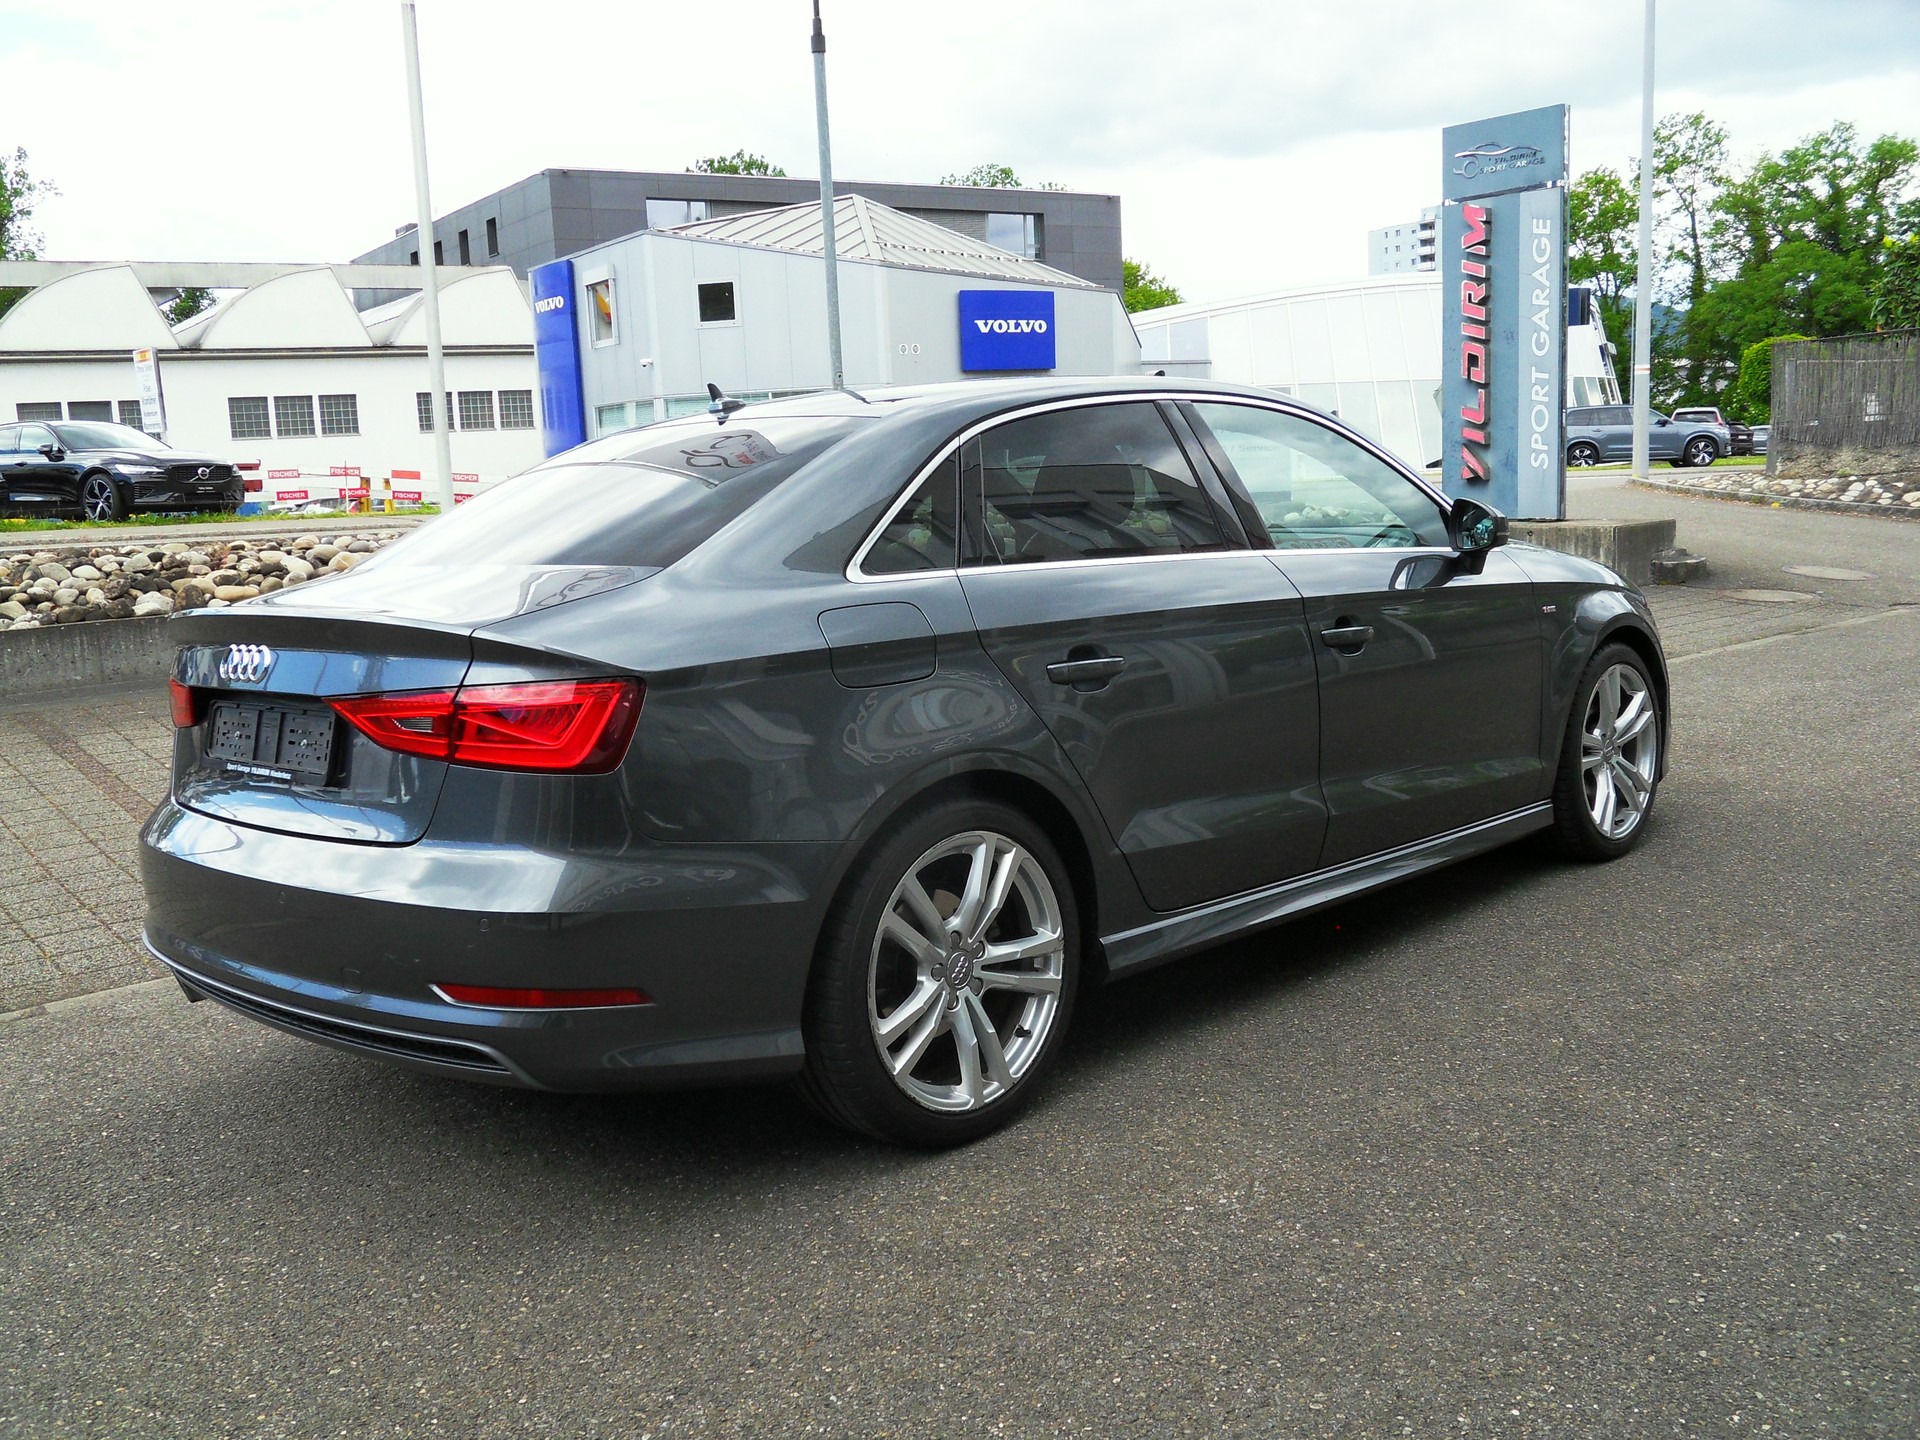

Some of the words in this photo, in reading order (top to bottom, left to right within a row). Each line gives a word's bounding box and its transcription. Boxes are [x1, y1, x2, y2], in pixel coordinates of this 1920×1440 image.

[1479, 164, 1506, 175] SPORT
[1509, 157, 1545, 169] GARAGE
[1531, 218, 1552, 357] GARAGE
[535, 295, 564, 313] VOLVO
[974, 319, 1047, 333] VOLVO
[1461, 202, 1491, 480] YILDIRIM
[1530, 366, 1550, 470] SPORT
[268, 470, 299, 478] FISCHER
[330, 468, 360, 476] FISCHER
[279, 491, 305, 499] FISCHER
